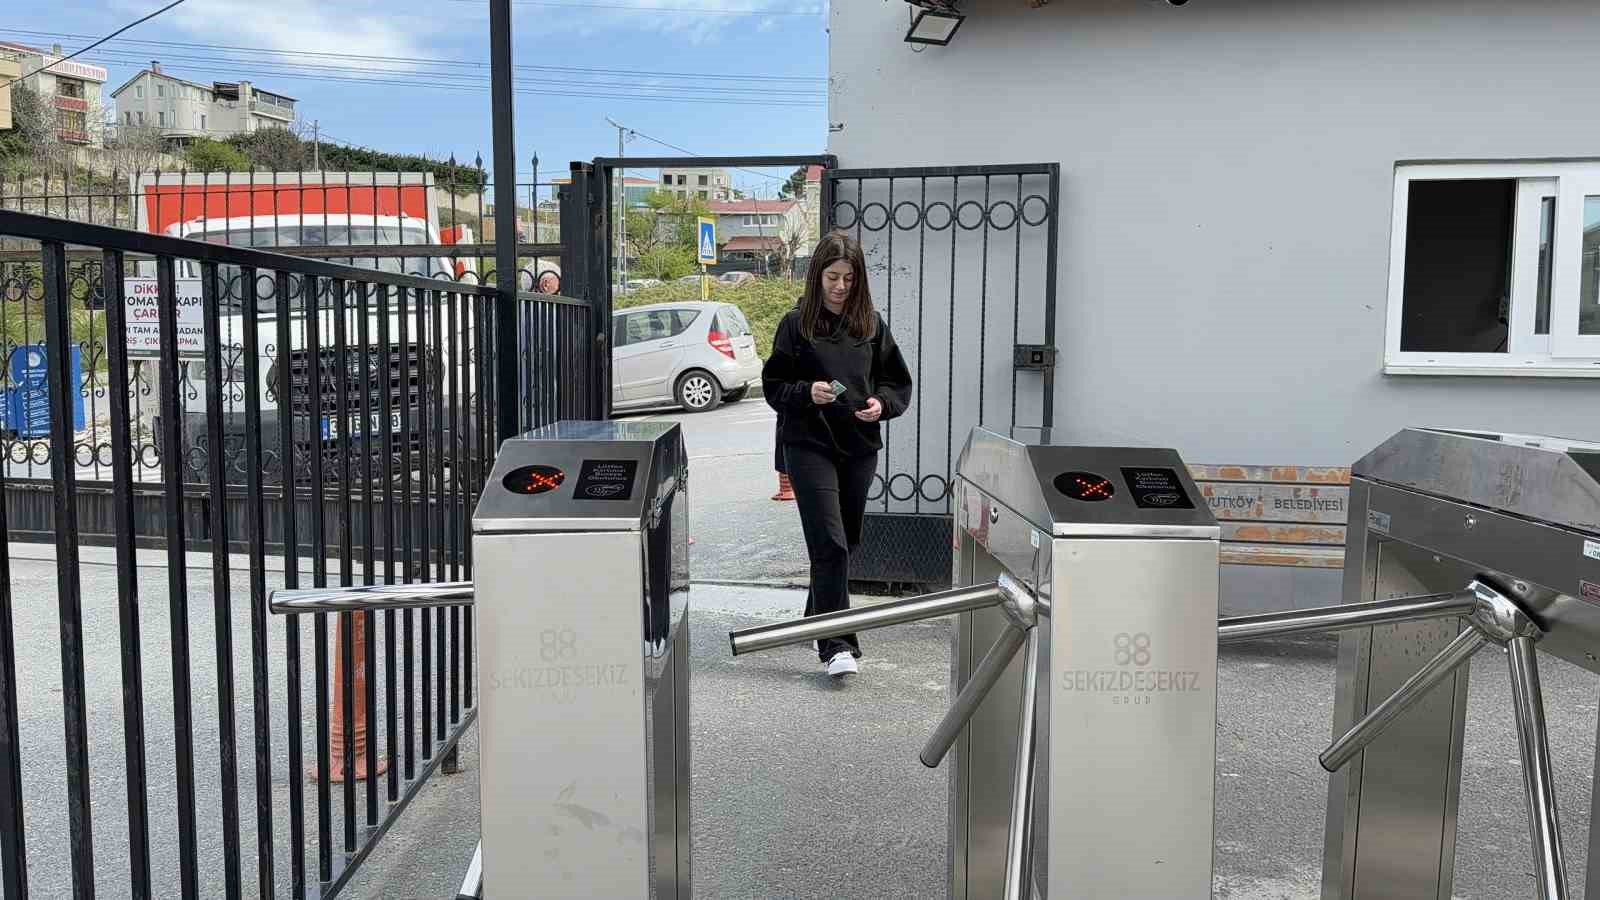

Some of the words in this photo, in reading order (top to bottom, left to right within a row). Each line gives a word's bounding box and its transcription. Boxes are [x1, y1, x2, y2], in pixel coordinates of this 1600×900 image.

[1274, 497, 1343, 511] BELEDİYESİ
[540, 627, 576, 661] 88
[1113, 632, 1151, 666] 88
